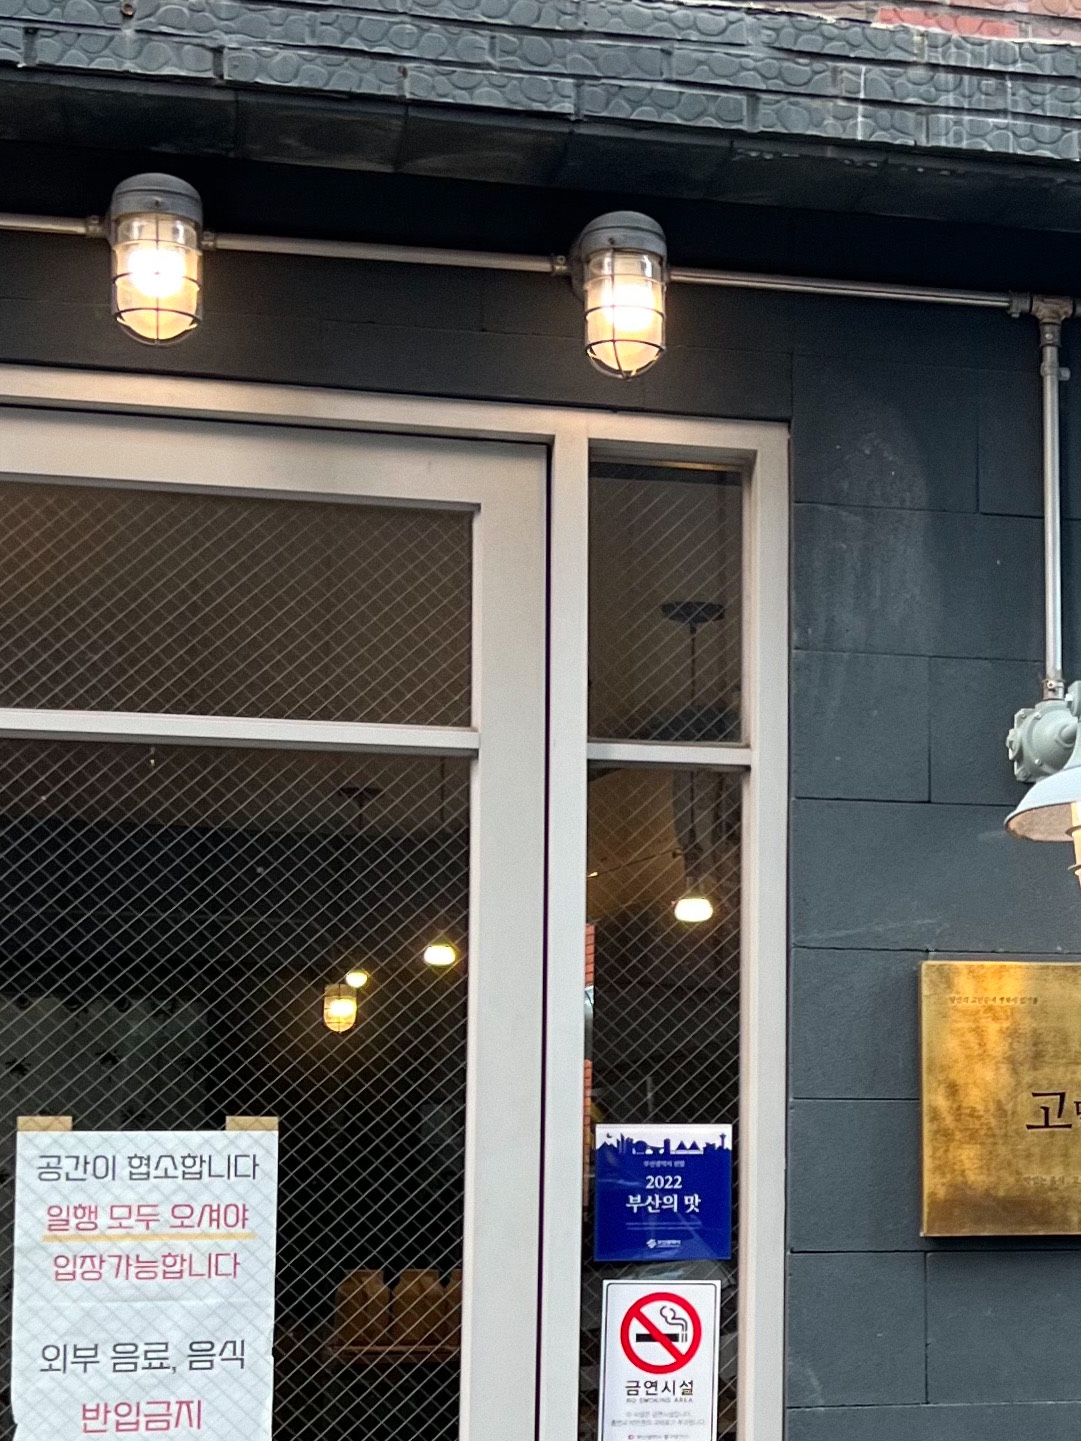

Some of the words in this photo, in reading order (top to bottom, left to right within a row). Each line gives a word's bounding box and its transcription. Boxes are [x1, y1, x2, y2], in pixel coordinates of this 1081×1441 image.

[36, 1154, 116, 1182] 공간이
[127, 1152, 260, 1181] 협소합니다
[645, 1175, 683, 1189] 2022
[47, 1203, 98, 1231] 일행
[107, 1204, 160, 1230] 모두
[169, 1203, 249, 1229] 오셔야
[625, 1193, 678, 1214] 부산의
[683, 1193, 702, 1213] 맛
[54, 1252, 241, 1282] 입장가능합니다
[40, 1343, 100, 1374] 외부
[111, 1341, 177, 1374] 음료,
[187, 1339, 246, 1371] 음식
[625, 1380, 694, 1396] 금연시설
[82, 1399, 202, 1434] 반입금지
